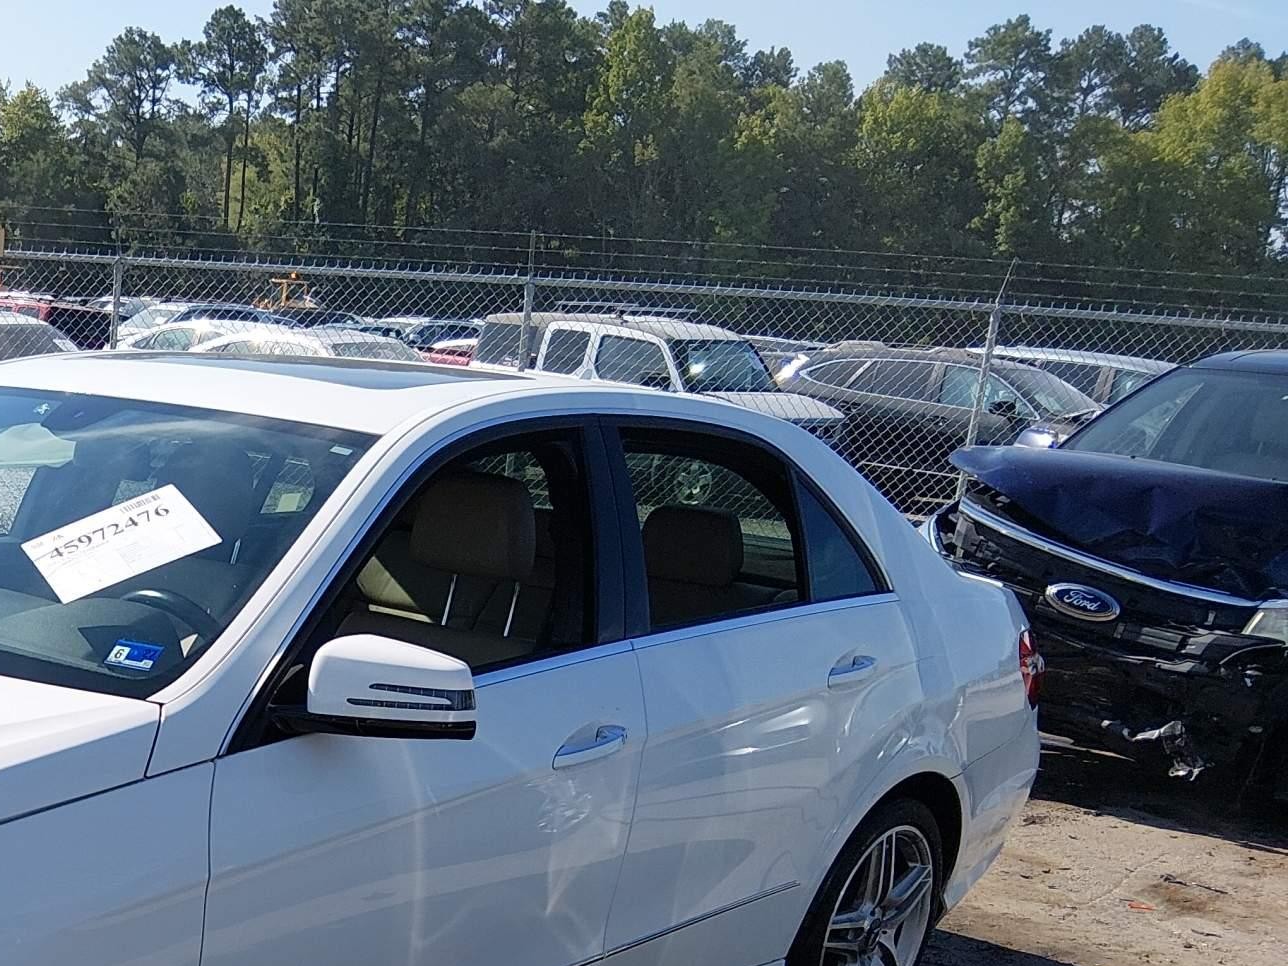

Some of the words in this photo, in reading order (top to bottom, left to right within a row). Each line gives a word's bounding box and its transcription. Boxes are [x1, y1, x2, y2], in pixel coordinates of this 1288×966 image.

[49, 505, 170, 559] 45972476
[1063, 590, 1101, 611] Ford
[113, 648, 125, 659] 6
